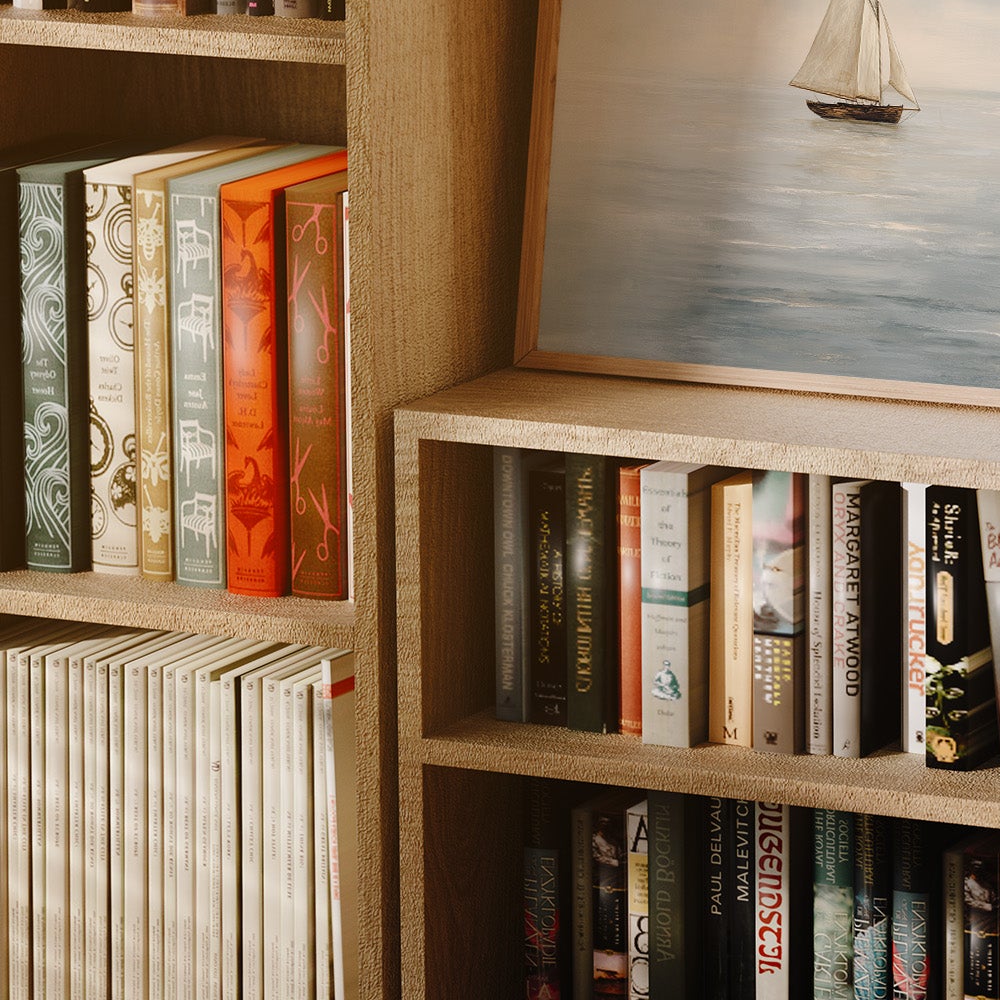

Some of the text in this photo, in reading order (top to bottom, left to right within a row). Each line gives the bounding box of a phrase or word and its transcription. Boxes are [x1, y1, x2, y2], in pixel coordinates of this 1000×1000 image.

[661, 504, 671, 513] of
[833, 491, 847, 545] ORYX
[650, 537, 682, 550] Theory
[662, 555, 671, 564] of
[650, 571, 682, 582] Fiction
[845, 493, 860, 697] MARGARET ATWOOD
[832, 600, 845, 671] CRAKE
[710, 797, 722, 915] PAUL DELVAU
